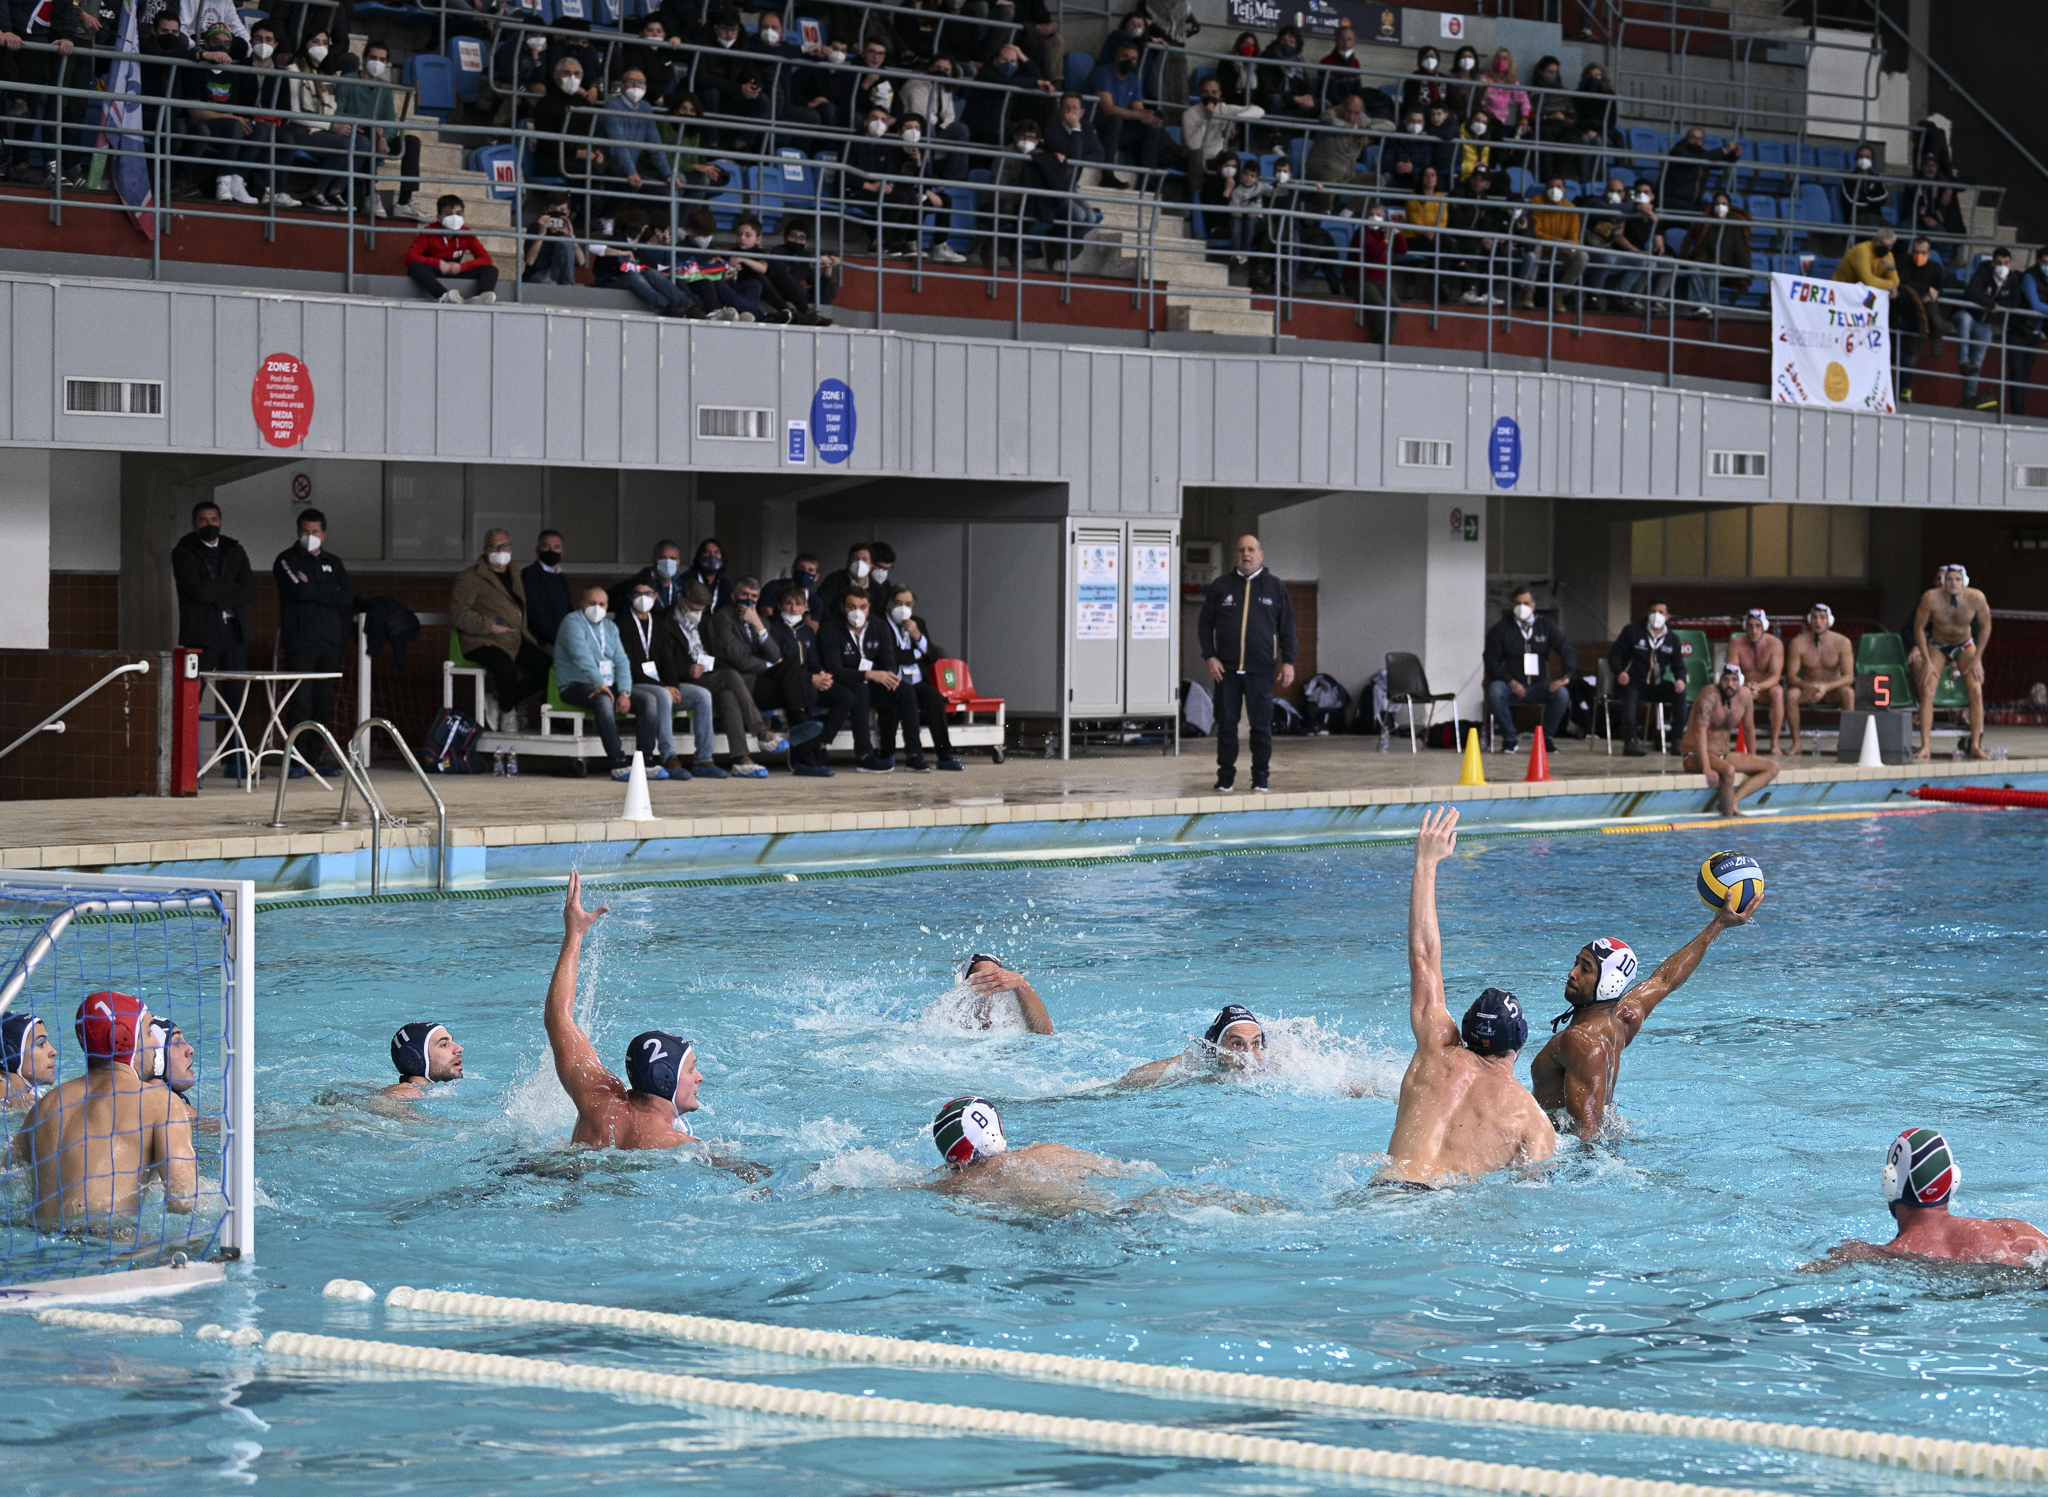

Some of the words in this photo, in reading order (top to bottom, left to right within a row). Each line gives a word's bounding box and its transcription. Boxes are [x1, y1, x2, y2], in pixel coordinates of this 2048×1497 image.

[803, 26, 818, 42] NO
[1790, 281, 1836, 306] FORZA
[267, 362, 291, 372] ZONE
[292, 363, 298, 373] 2
[266, 384, 299, 392] surroundings
[821, 391, 840, 400] ZONE
[271, 410, 293, 419] MEDIA
[826, 414, 841, 422] TEAM
[271, 421, 294, 429] PHOTO
[826, 424, 840, 432] STAFF
[828, 435, 838, 443] LEN
[945, 672, 954, 683] SI
[1874, 676, 1890, 706] 5
[1616, 954, 1636, 977] 10
[94, 1000, 116, 1022] 1
[1504, 996, 1519, 1018] 5
[393, 1028, 410, 1049] 11
[643, 1038, 668, 1063] 2
[971, 1111, 988, 1129] 8
[1891, 1143, 1902, 1166] 6
